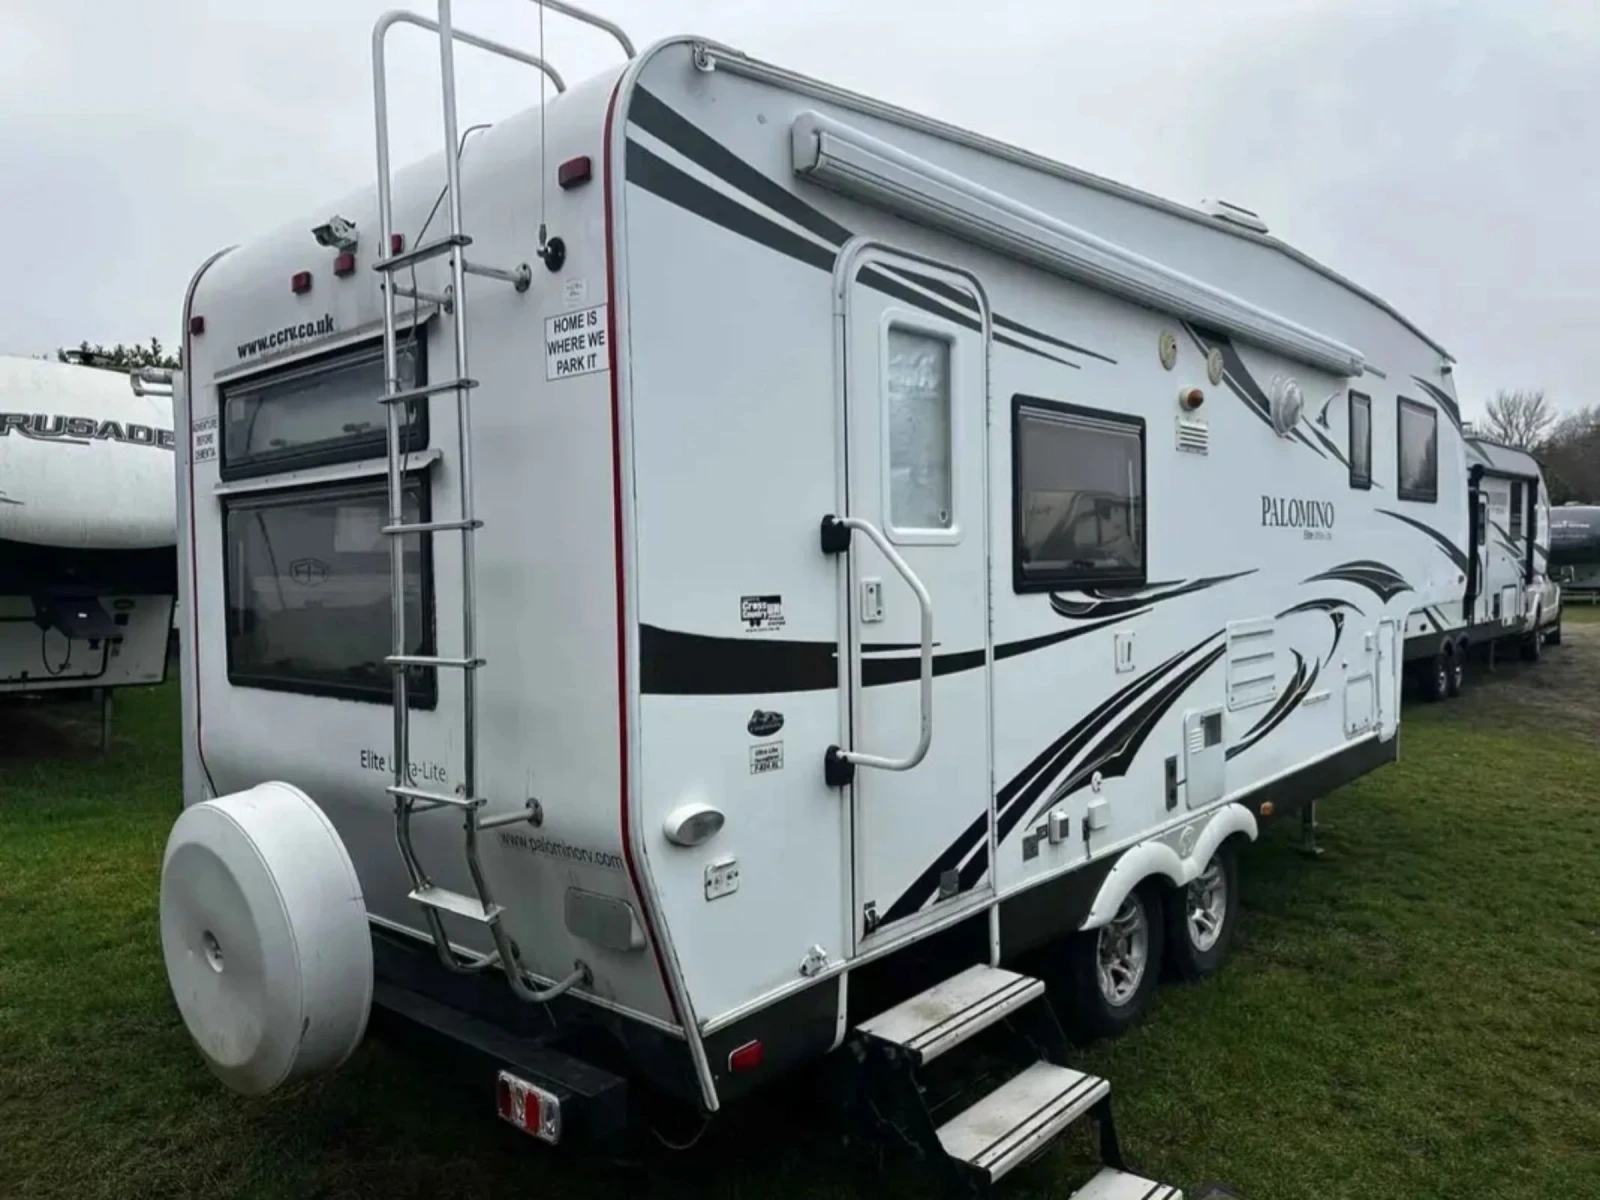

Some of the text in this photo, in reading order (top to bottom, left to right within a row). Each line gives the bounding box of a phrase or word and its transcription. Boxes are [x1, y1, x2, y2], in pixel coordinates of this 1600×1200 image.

[553, 310, 597, 333] HOME IS
[237, 313, 334, 359] www.ccrv.co.uk
[547, 330, 605, 356] WHERE WE
[556, 353, 597, 375] PARK IT
[1261, 495, 1334, 529] PALOMINO
[360, 749, 385, 771] Elite
[499, 832, 624, 869] www.palominorv.com
